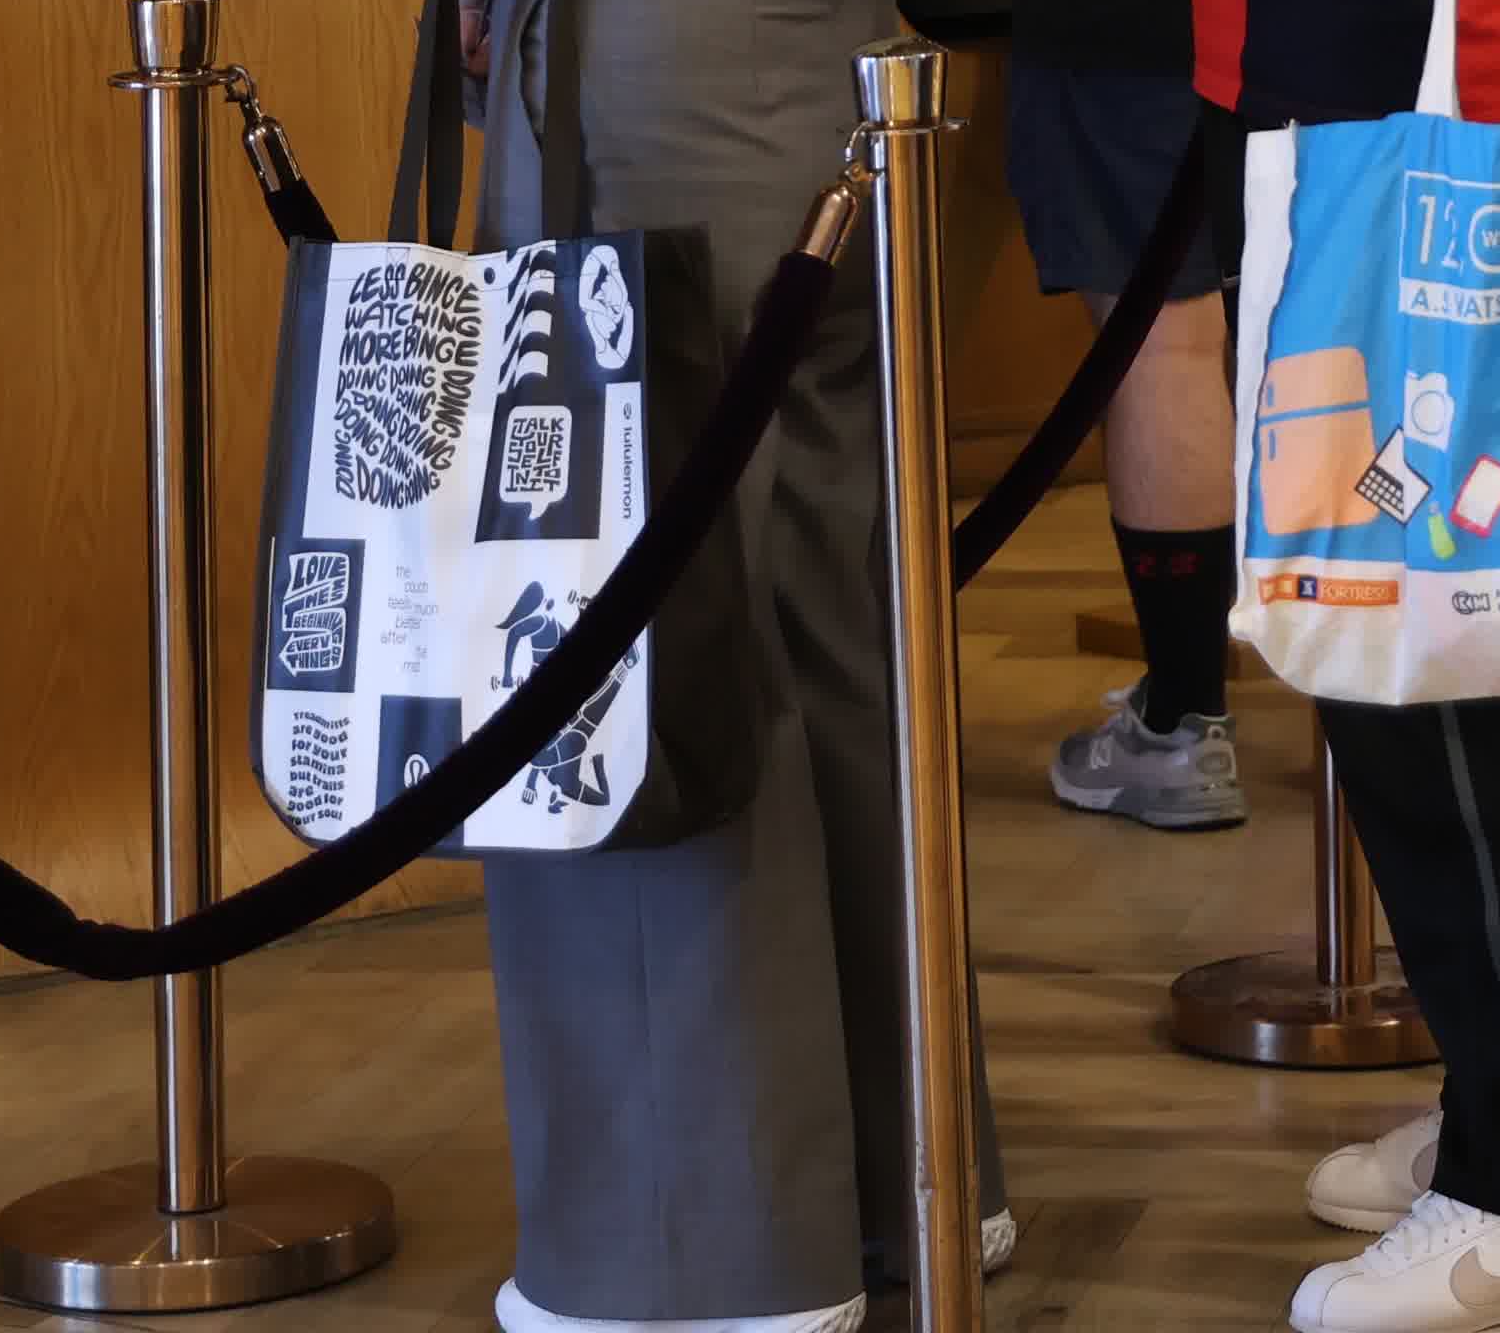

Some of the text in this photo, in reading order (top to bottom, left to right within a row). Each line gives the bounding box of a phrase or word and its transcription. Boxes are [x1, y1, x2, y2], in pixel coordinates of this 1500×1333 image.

[349, 262, 480, 314] LESS BINGE
[345, 300, 482, 337] WATCHING
[340, 325, 481, 367] MORE BINGE
[336, 363, 436, 403] DOING DOING
[351, 390, 400, 437] DOING
[397, 389, 437, 422] DOING
[431, 370, 475, 439] DOING
[334, 398, 383, 457] DOING
[398, 415, 455, 470] DOING
[511, 423, 564, 455] YOUR
[513, 418, 564, 433] TALK
[335, 429, 355, 499] DOING
[380, 437, 413, 479] DOING
[508, 442, 562, 468] SELF
[622, 426, 634, 520] lululemon
[356, 455, 404, 509] DOING
[404, 465, 440, 508] DOING
[291, 556, 346, 593] LOVE
[291, 739, 348, 761] for your
[292, 724, 348, 745] are good
[290, 755, 345, 775] stamina
[290, 770, 345, 791] but trails
[287, 793, 344, 812] good for
[288, 785, 314, 798] are
[317, 808, 343, 822] soul
